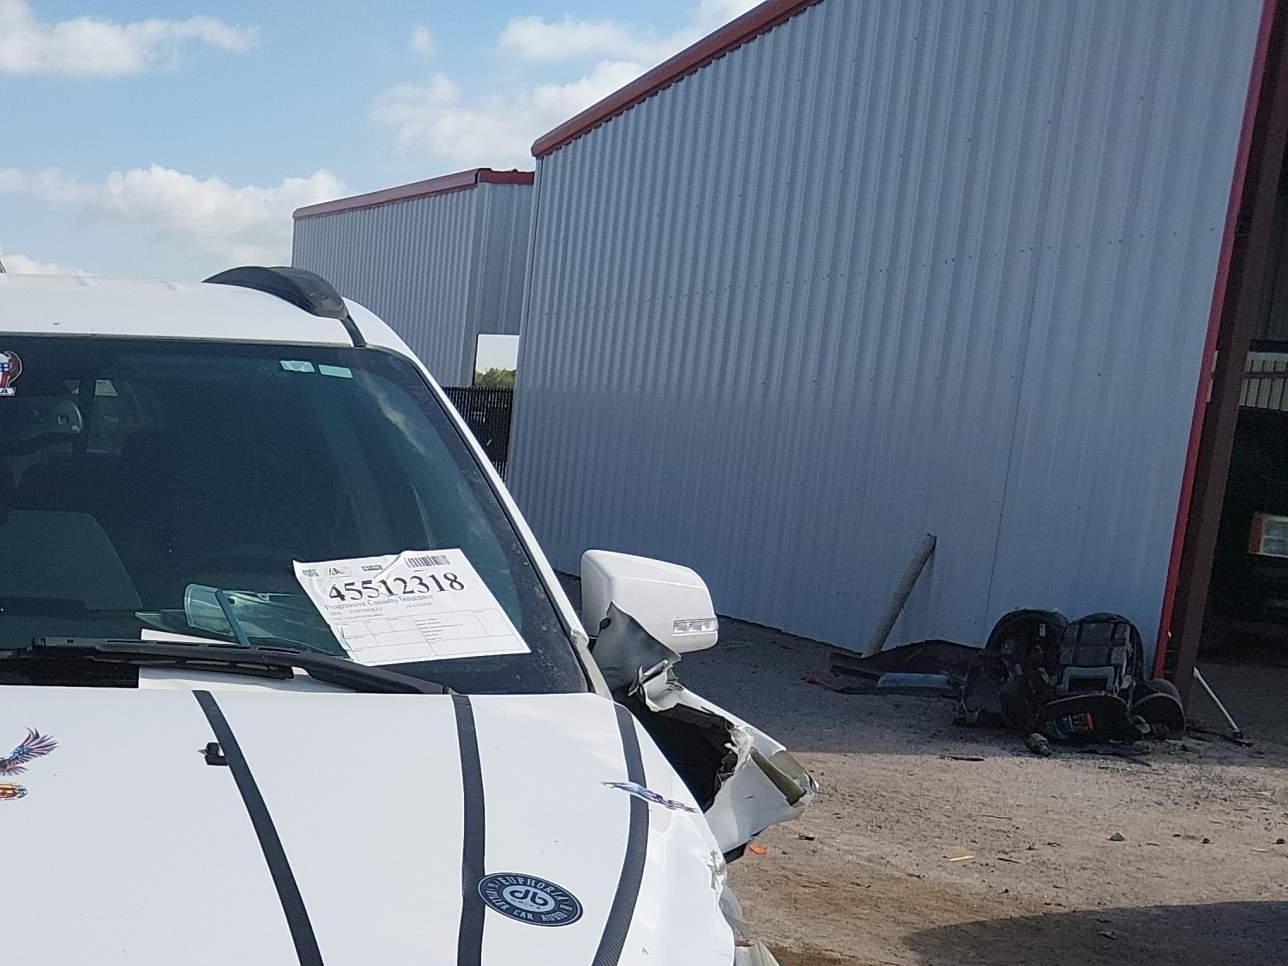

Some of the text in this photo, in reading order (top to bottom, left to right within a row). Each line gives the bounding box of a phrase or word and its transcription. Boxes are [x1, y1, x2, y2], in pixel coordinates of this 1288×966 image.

[329, 572, 465, 601] 45512318
[497, 876, 570, 901] EUPHORIA
[513, 909, 534, 921] CAR
